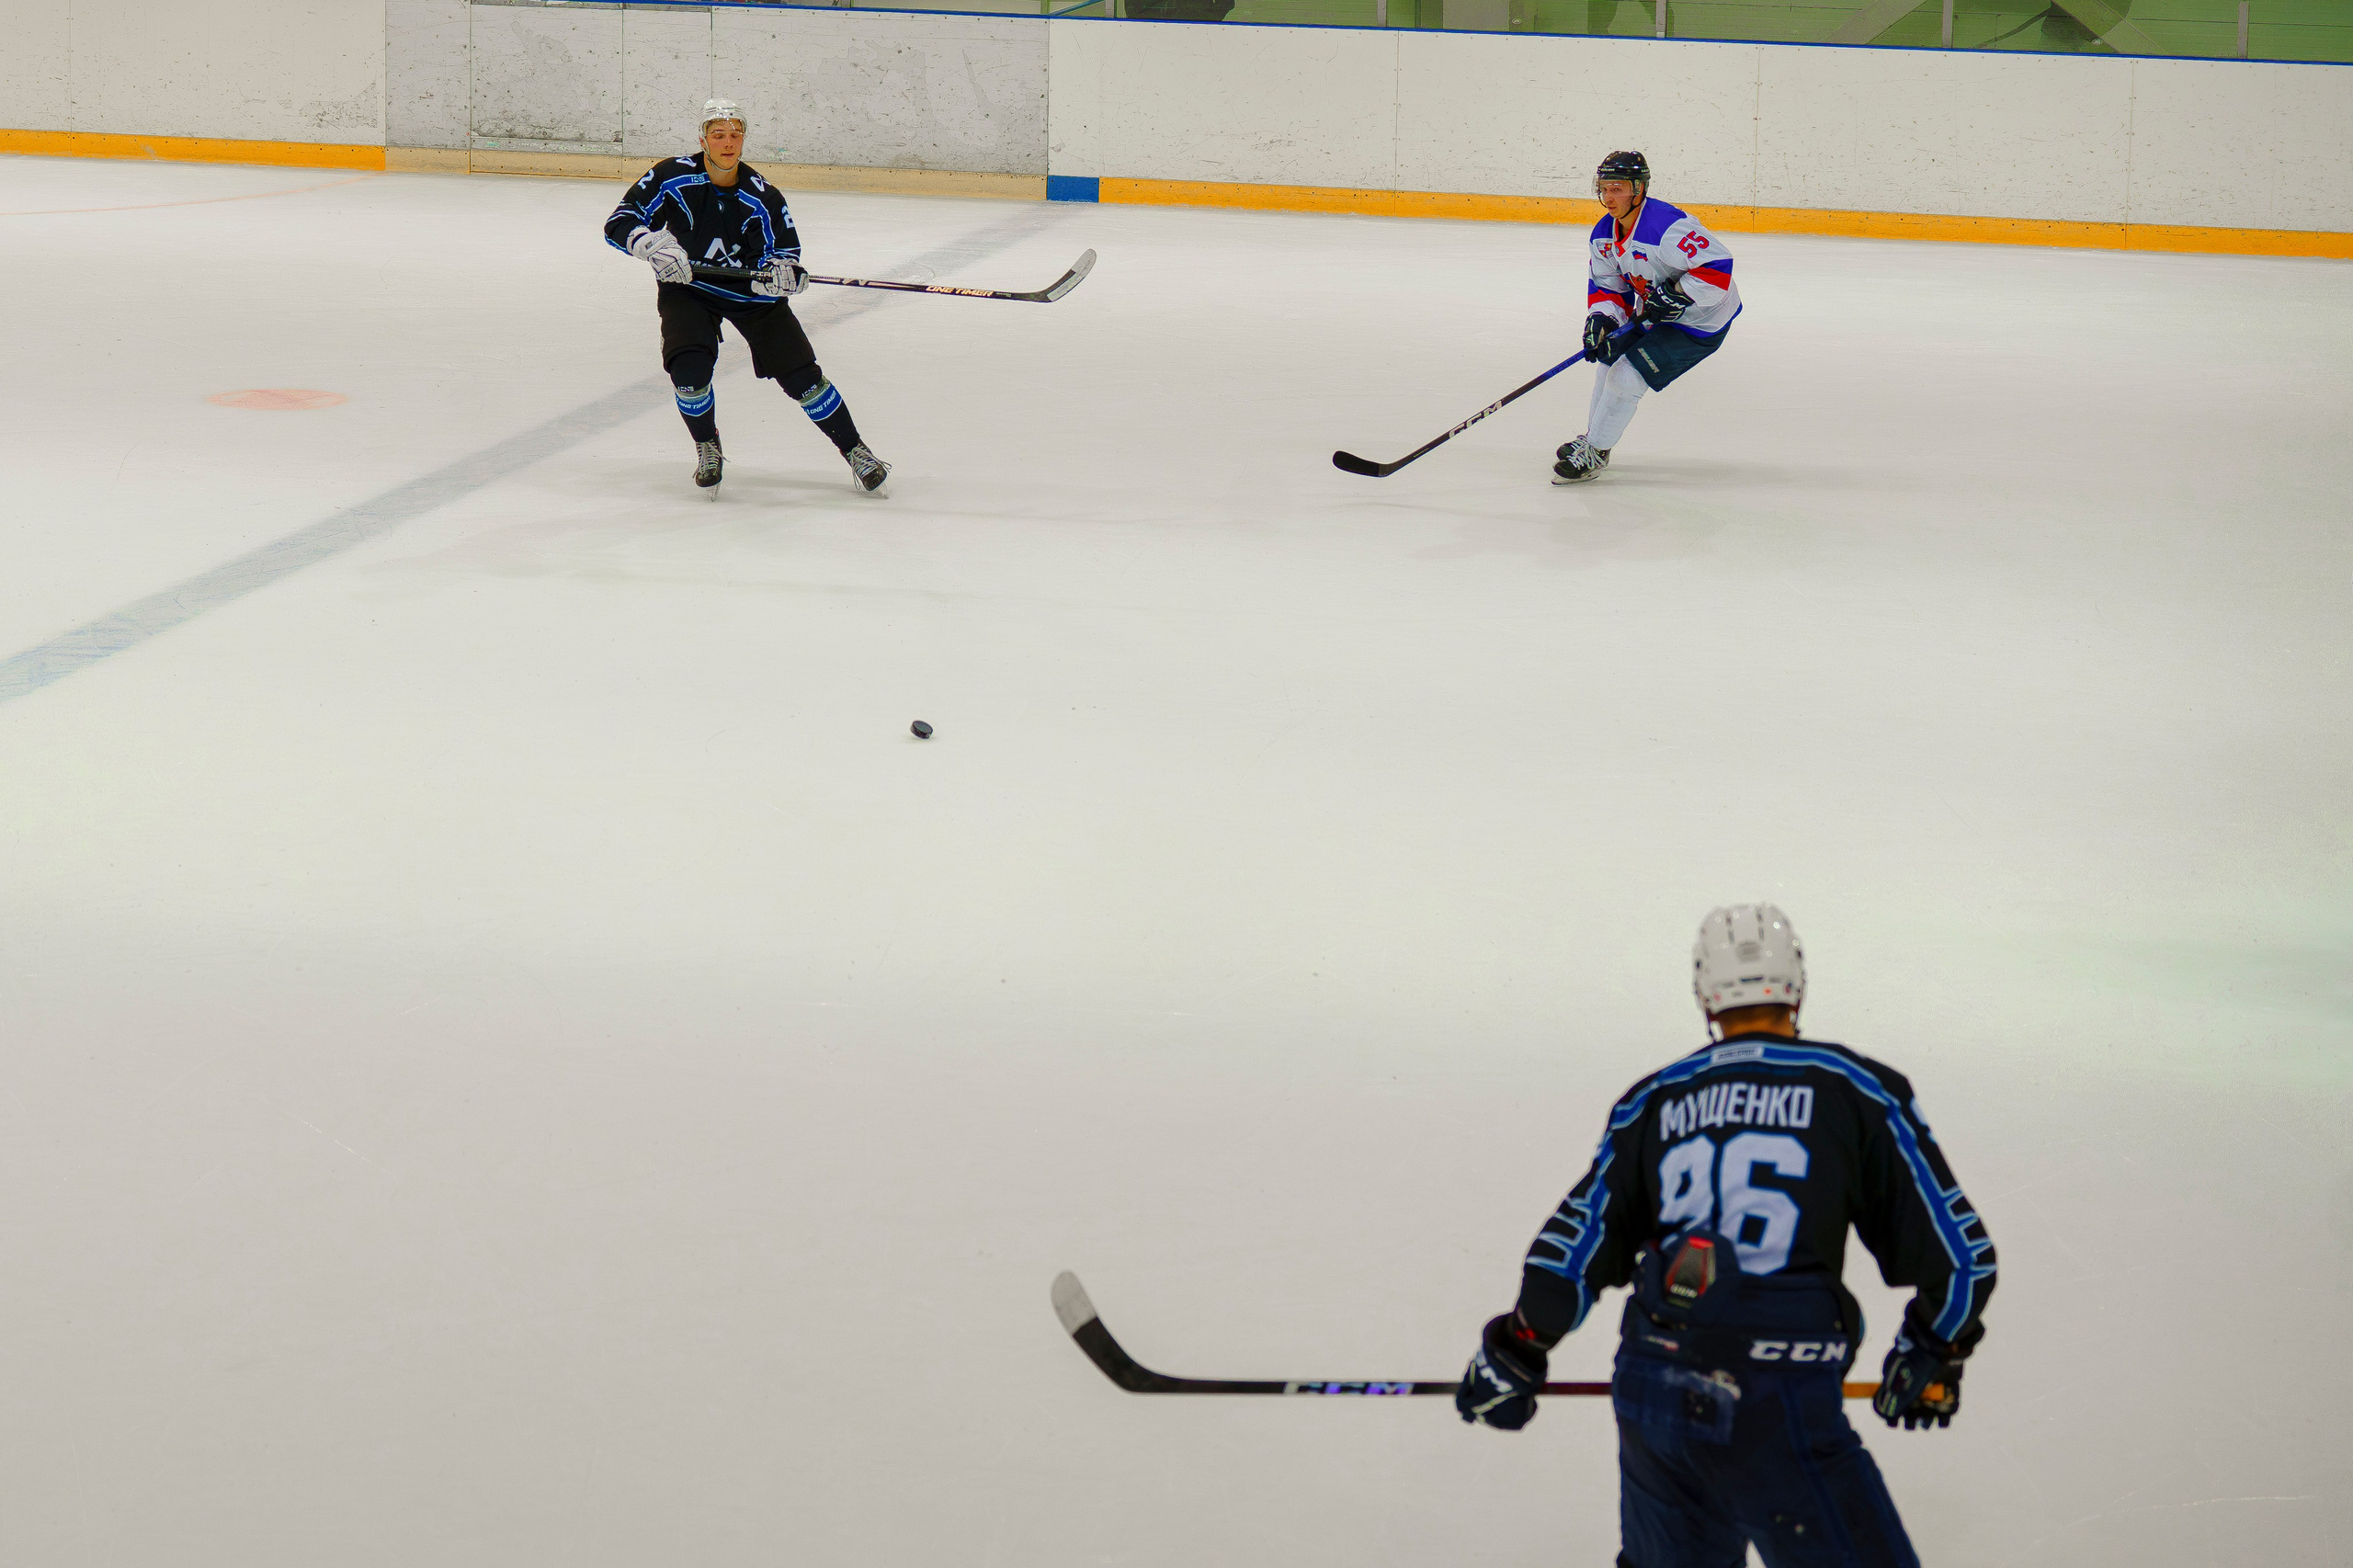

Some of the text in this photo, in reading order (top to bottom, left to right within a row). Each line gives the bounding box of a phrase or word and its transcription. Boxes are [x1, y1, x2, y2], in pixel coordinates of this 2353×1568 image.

[1677, 230, 1710, 259] 55
[955, 288, 994, 297] TIMER
[1656, 286, 1687, 310] CCM
[1449, 400, 1503, 438] CCM
[1659, 1082, 1814, 1142] МУЩЕНКО
[1657, 1131, 1811, 1277] 96
[1282, 1381, 1415, 1395] CCM
